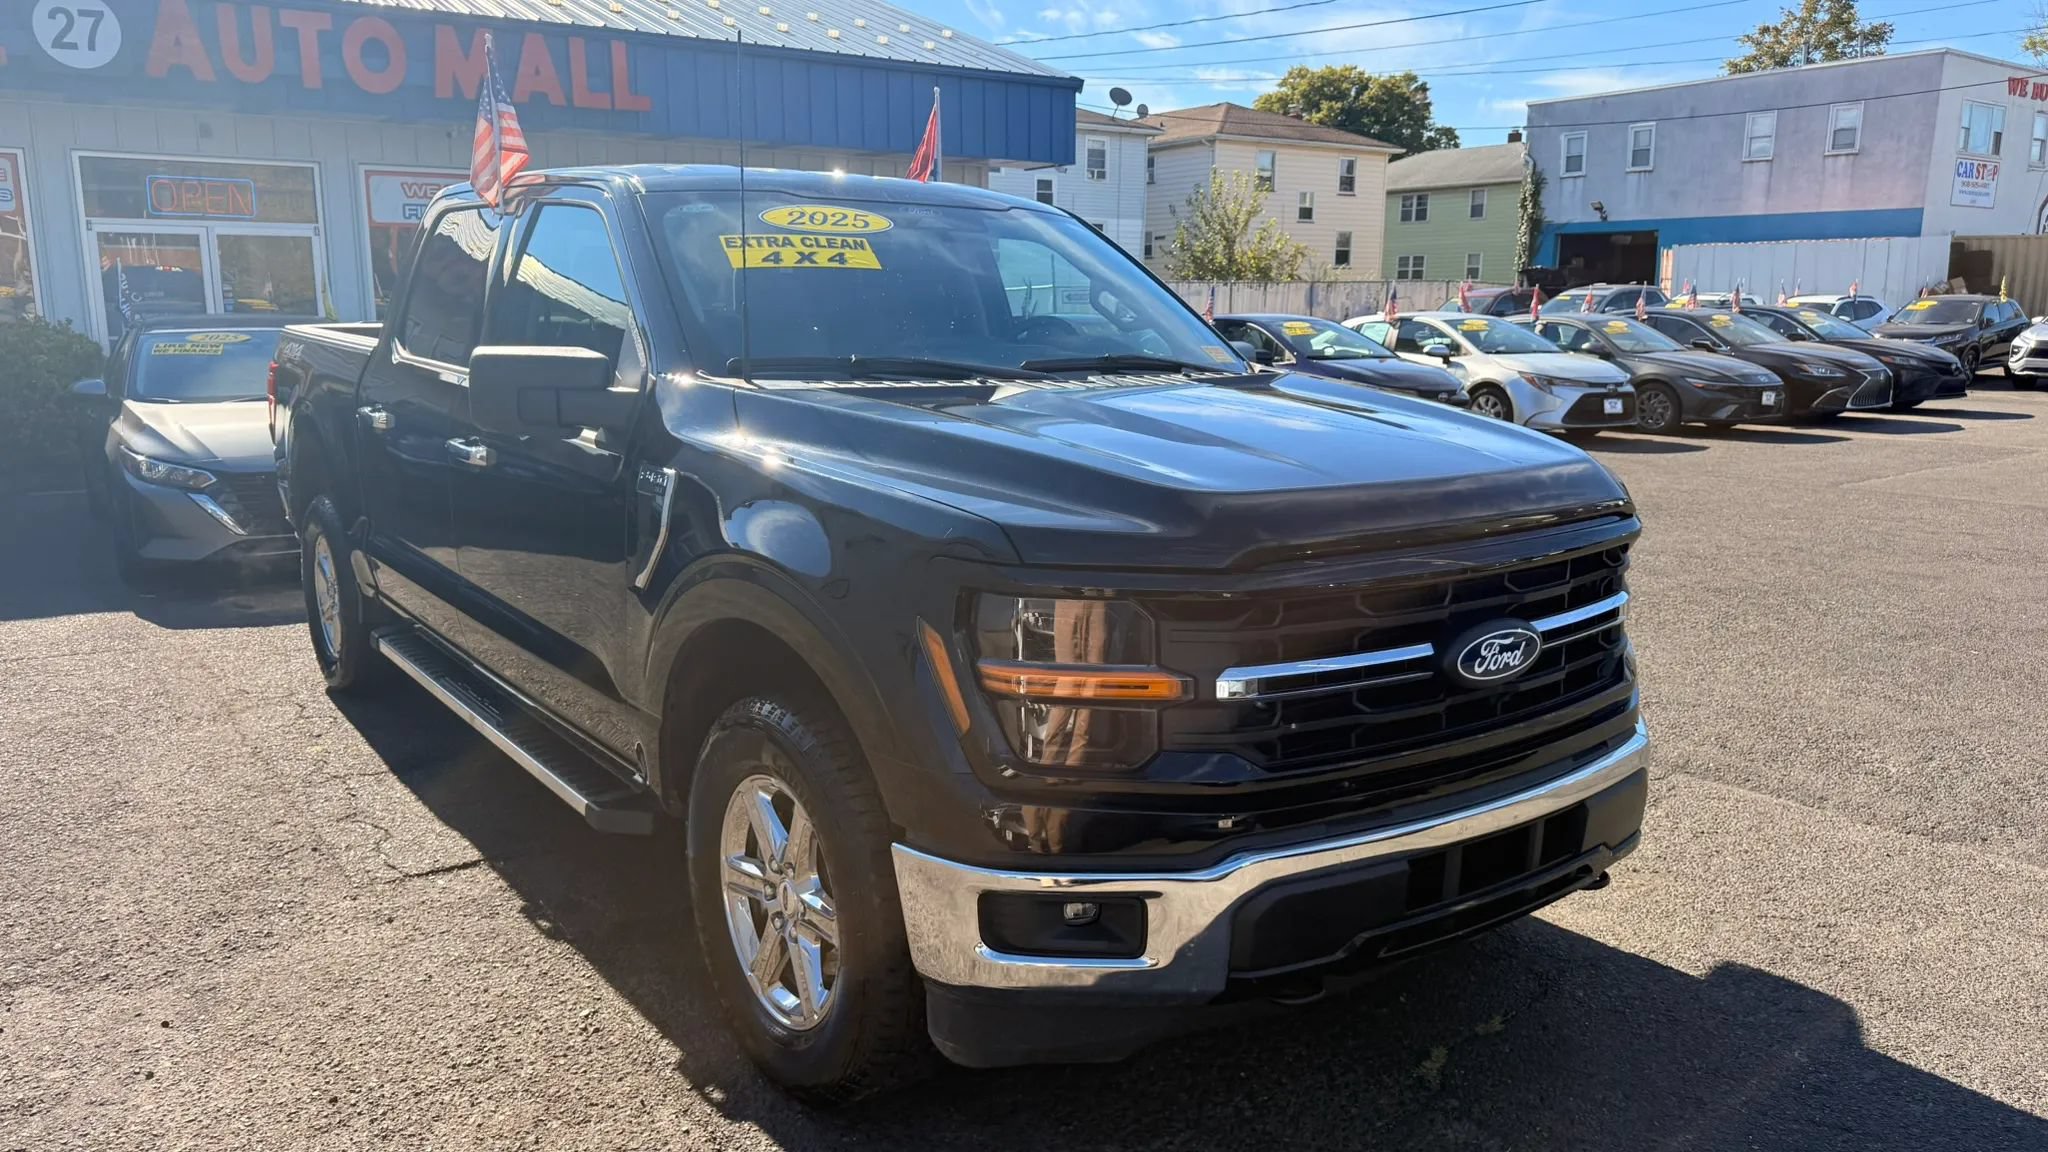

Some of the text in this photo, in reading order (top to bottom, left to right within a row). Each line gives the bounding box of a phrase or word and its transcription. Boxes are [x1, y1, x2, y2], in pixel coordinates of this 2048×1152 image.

[47, 6, 104, 51] 27
[145, 0, 651, 111] AUTO MALL
[2008, 77, 2028, 97] WE
[1956, 161, 1975, 179] CAR
[152, 180, 251, 213] OPEN
[788, 210, 870, 229] 2025
[725, 236, 865, 251] EXTRA CLEAN
[761, 252, 848, 265] 4 X 4
[1474, 636, 1526, 674] Ford
